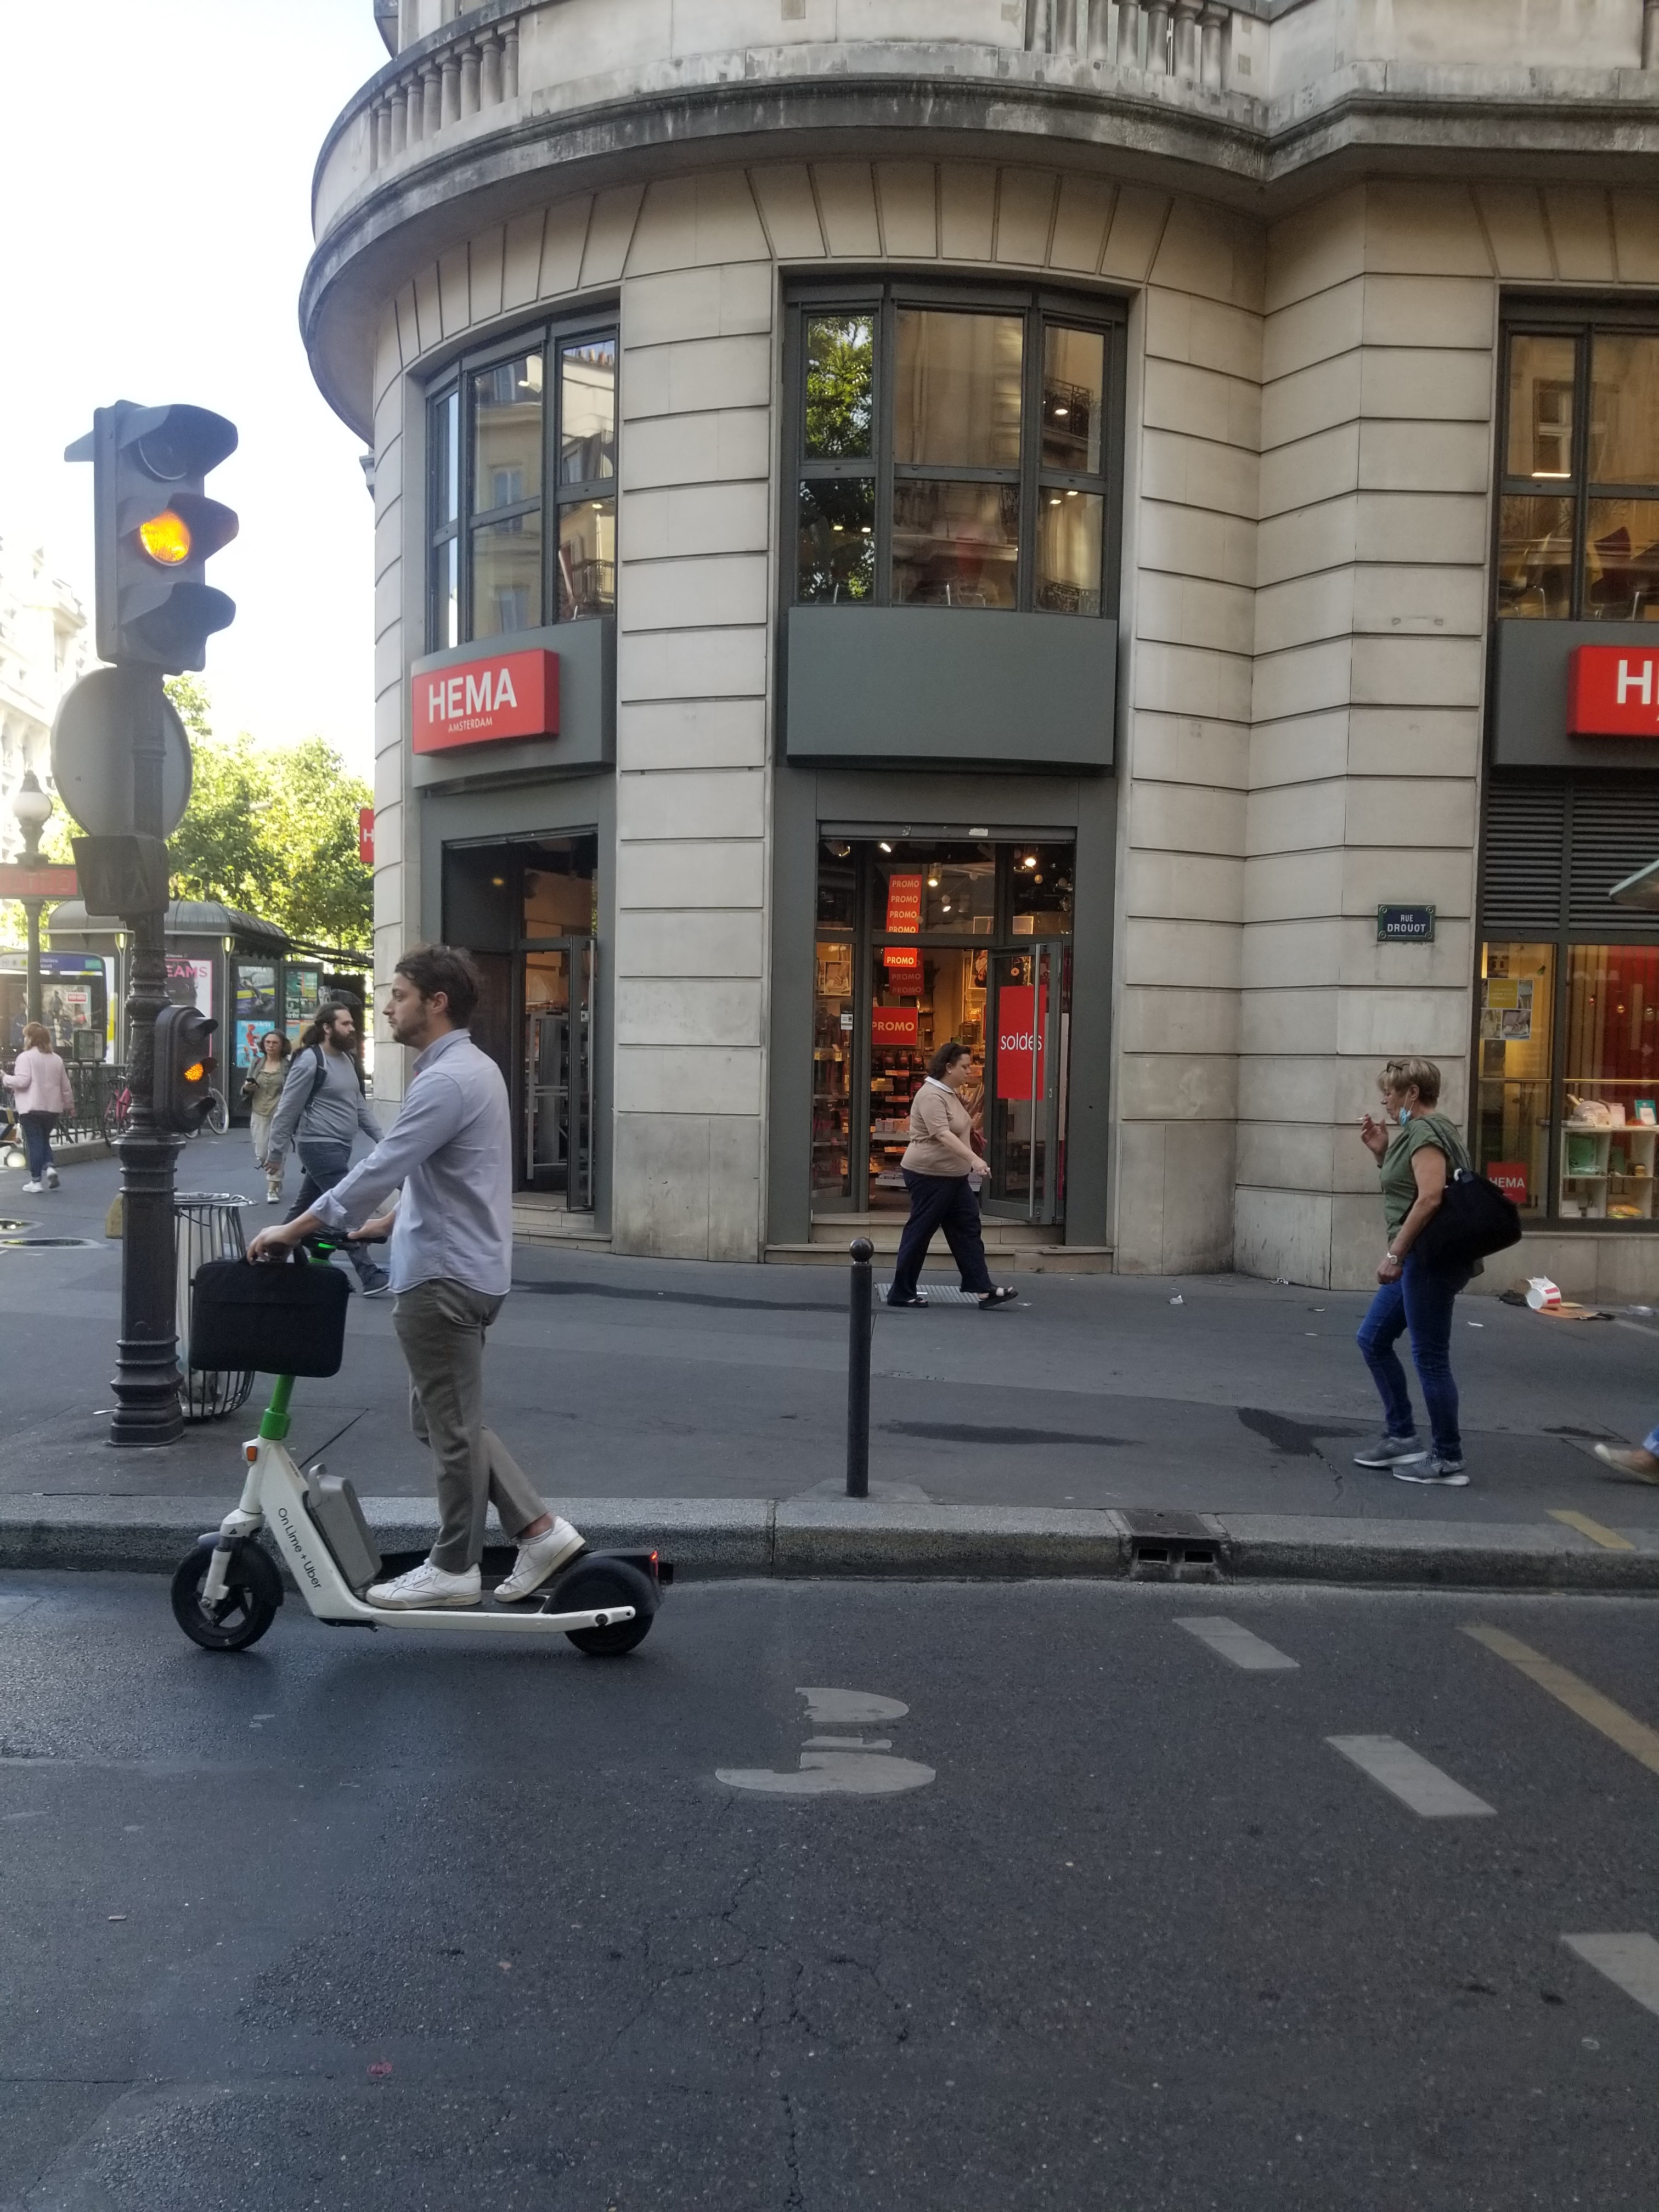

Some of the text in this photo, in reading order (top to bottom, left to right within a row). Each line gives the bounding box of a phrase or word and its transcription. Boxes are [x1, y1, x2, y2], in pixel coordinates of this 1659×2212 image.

[1617, 659, 1659, 704] H
[429, 668, 517, 723] HEMA
[448, 716, 493, 733] AMSTERDAM
[363, 828, 374, 843] H
[0, 872, 71, 891] ETRO
[1387, 924, 1426, 932] DROUOT
[887, 956, 914, 964] PROMO
[872, 1022, 915, 1031] PROMO
[1001, 1032, 1042, 1051] soldes
[1489, 1177, 1525, 1188] HEMA
[278, 1508, 289, 1526] On
[285, 1525, 302, 1553] Lime
[303, 1561, 322, 1588] Uber
